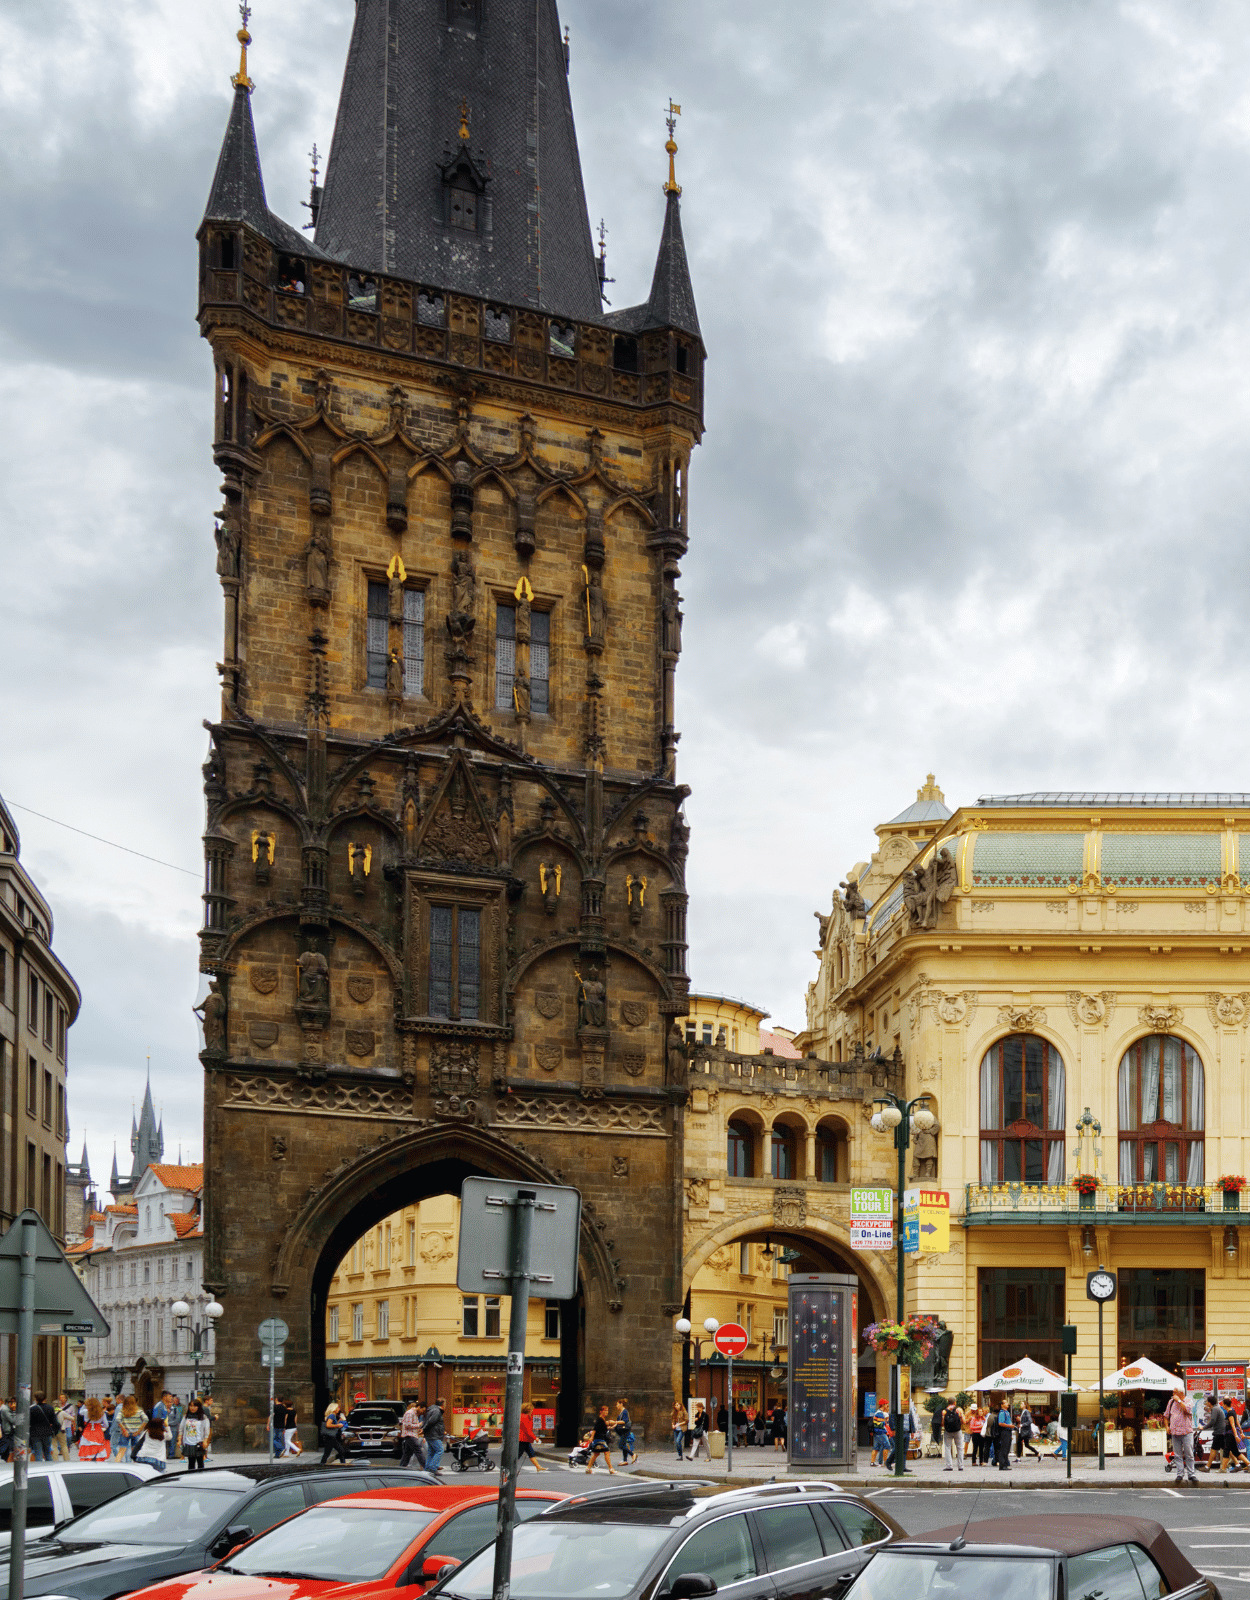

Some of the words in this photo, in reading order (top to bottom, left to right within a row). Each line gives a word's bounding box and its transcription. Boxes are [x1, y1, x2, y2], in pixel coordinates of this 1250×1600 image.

[854, 1191, 881, 1201] COOL
[854, 1201, 881, 1212] TOUR
[861, 1229, 892, 1238] On-Line
[993, 1378, 1018, 1388] Pilsner
[1019, 1377, 1044, 1385] Urquell
[1117, 1377, 1142, 1387] Pilsner
[1142, 1376, 1167, 1385] Urquell
